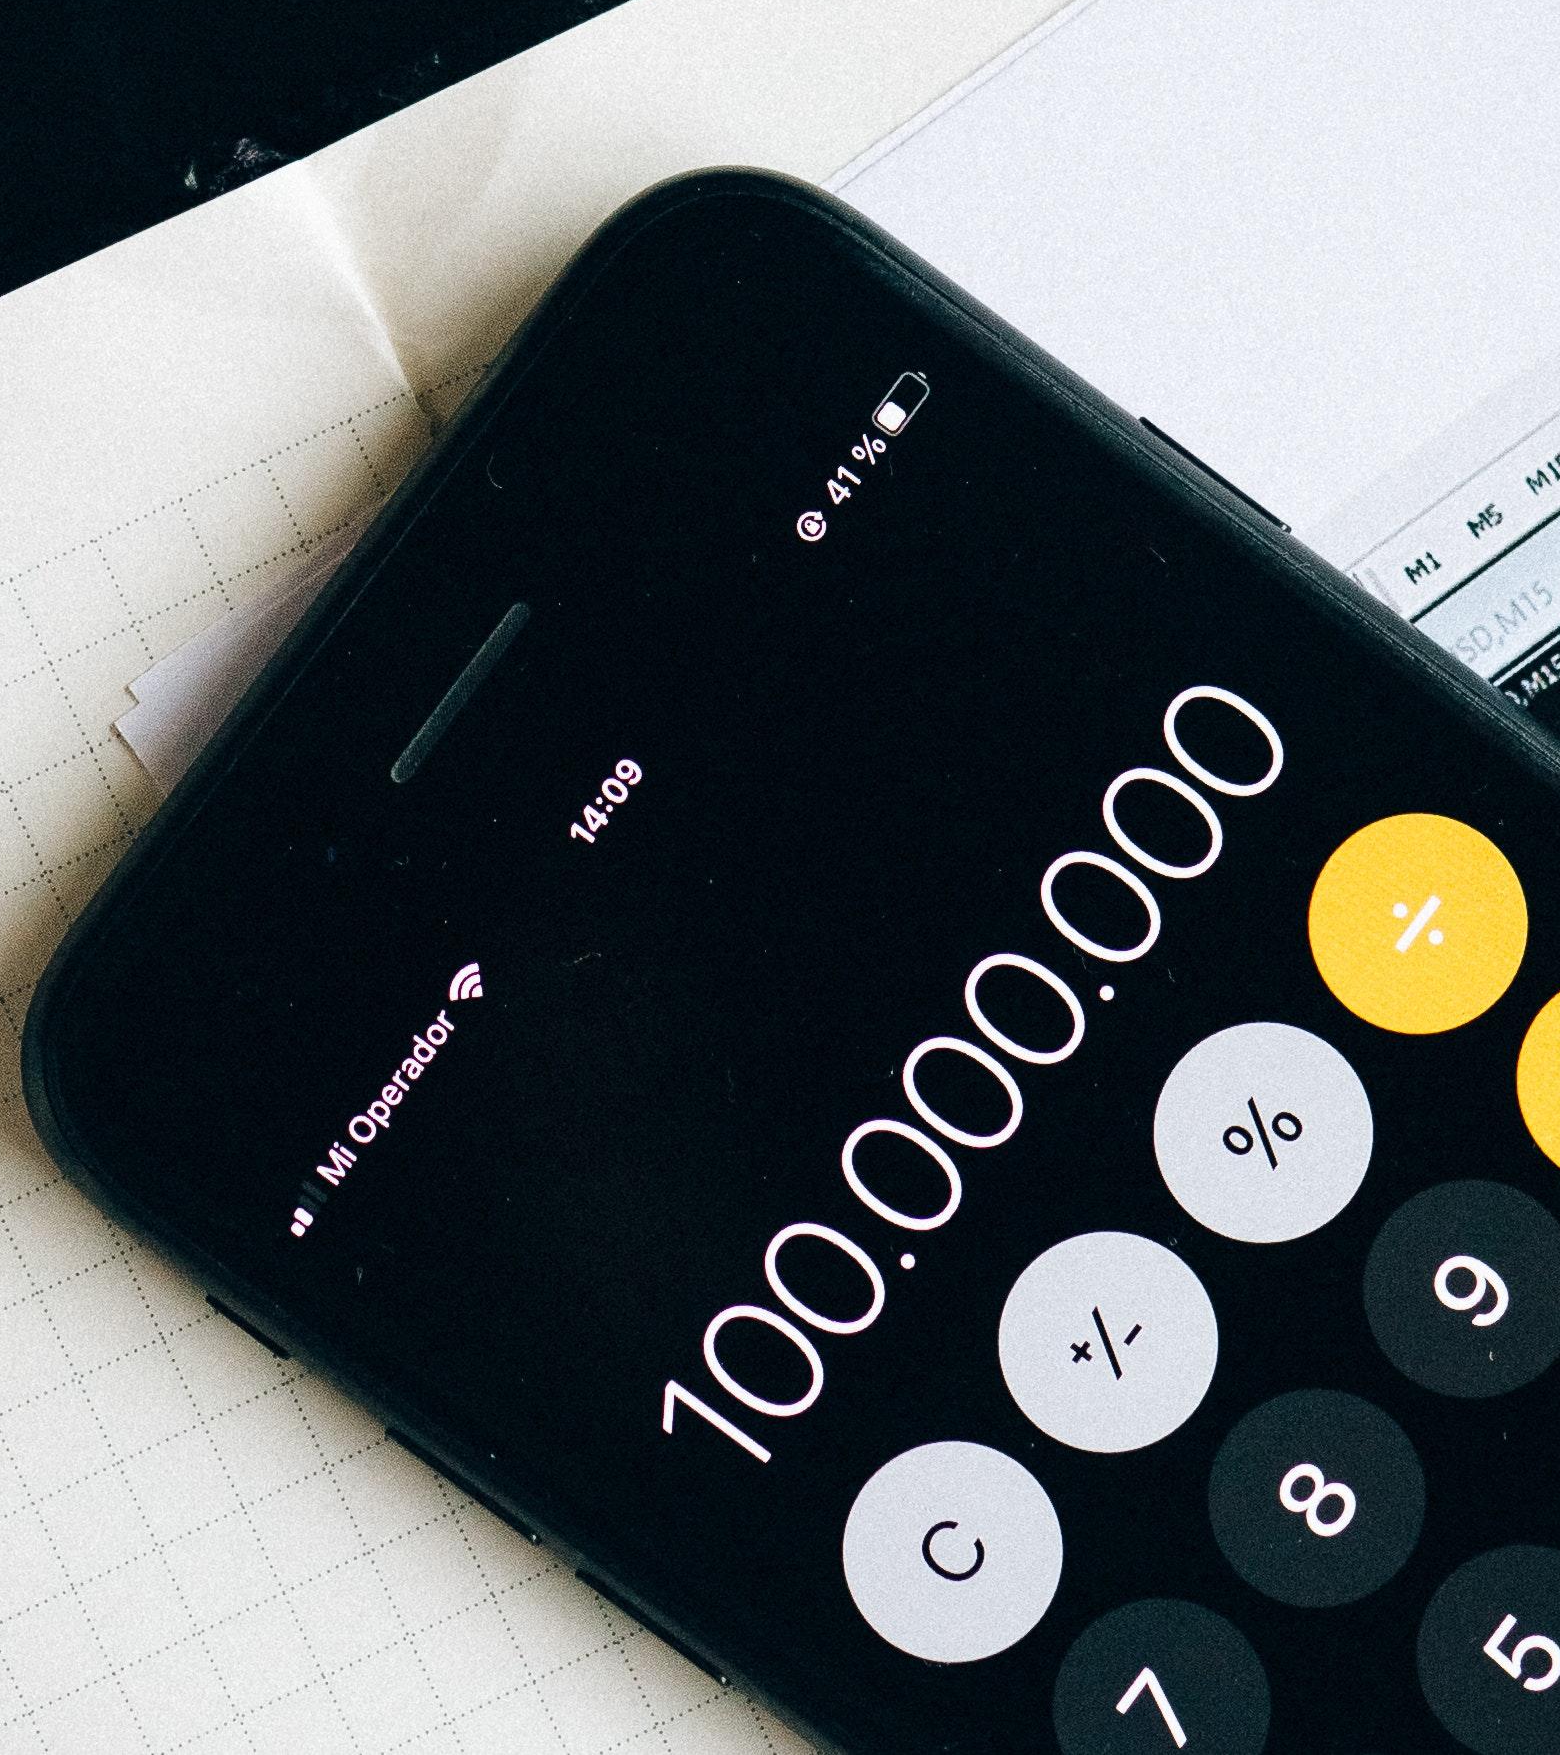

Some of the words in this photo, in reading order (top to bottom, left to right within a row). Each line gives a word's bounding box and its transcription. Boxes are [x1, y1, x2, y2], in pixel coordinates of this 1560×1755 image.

[826, 464, 863, 505] 41
[851, 433, 887, 465] %
[1404, 551, 1442, 585] M1
[1466, 503, 1503, 539] M5
[570, 759, 644, 844] 14:09
[316, 1140, 359, 1186] Mi
[348, 1009, 455, 1145] Operador
[662, 685, 1285, 1467] 100.000.000
[921, 1520, 985, 1582] C
[1222, 1097, 1303, 1170] %
[1115, 1667, 1187, 1749] 7
[1279, 1463, 1357, 1537] 8
[1433, 1255, 1510, 1327] 9
